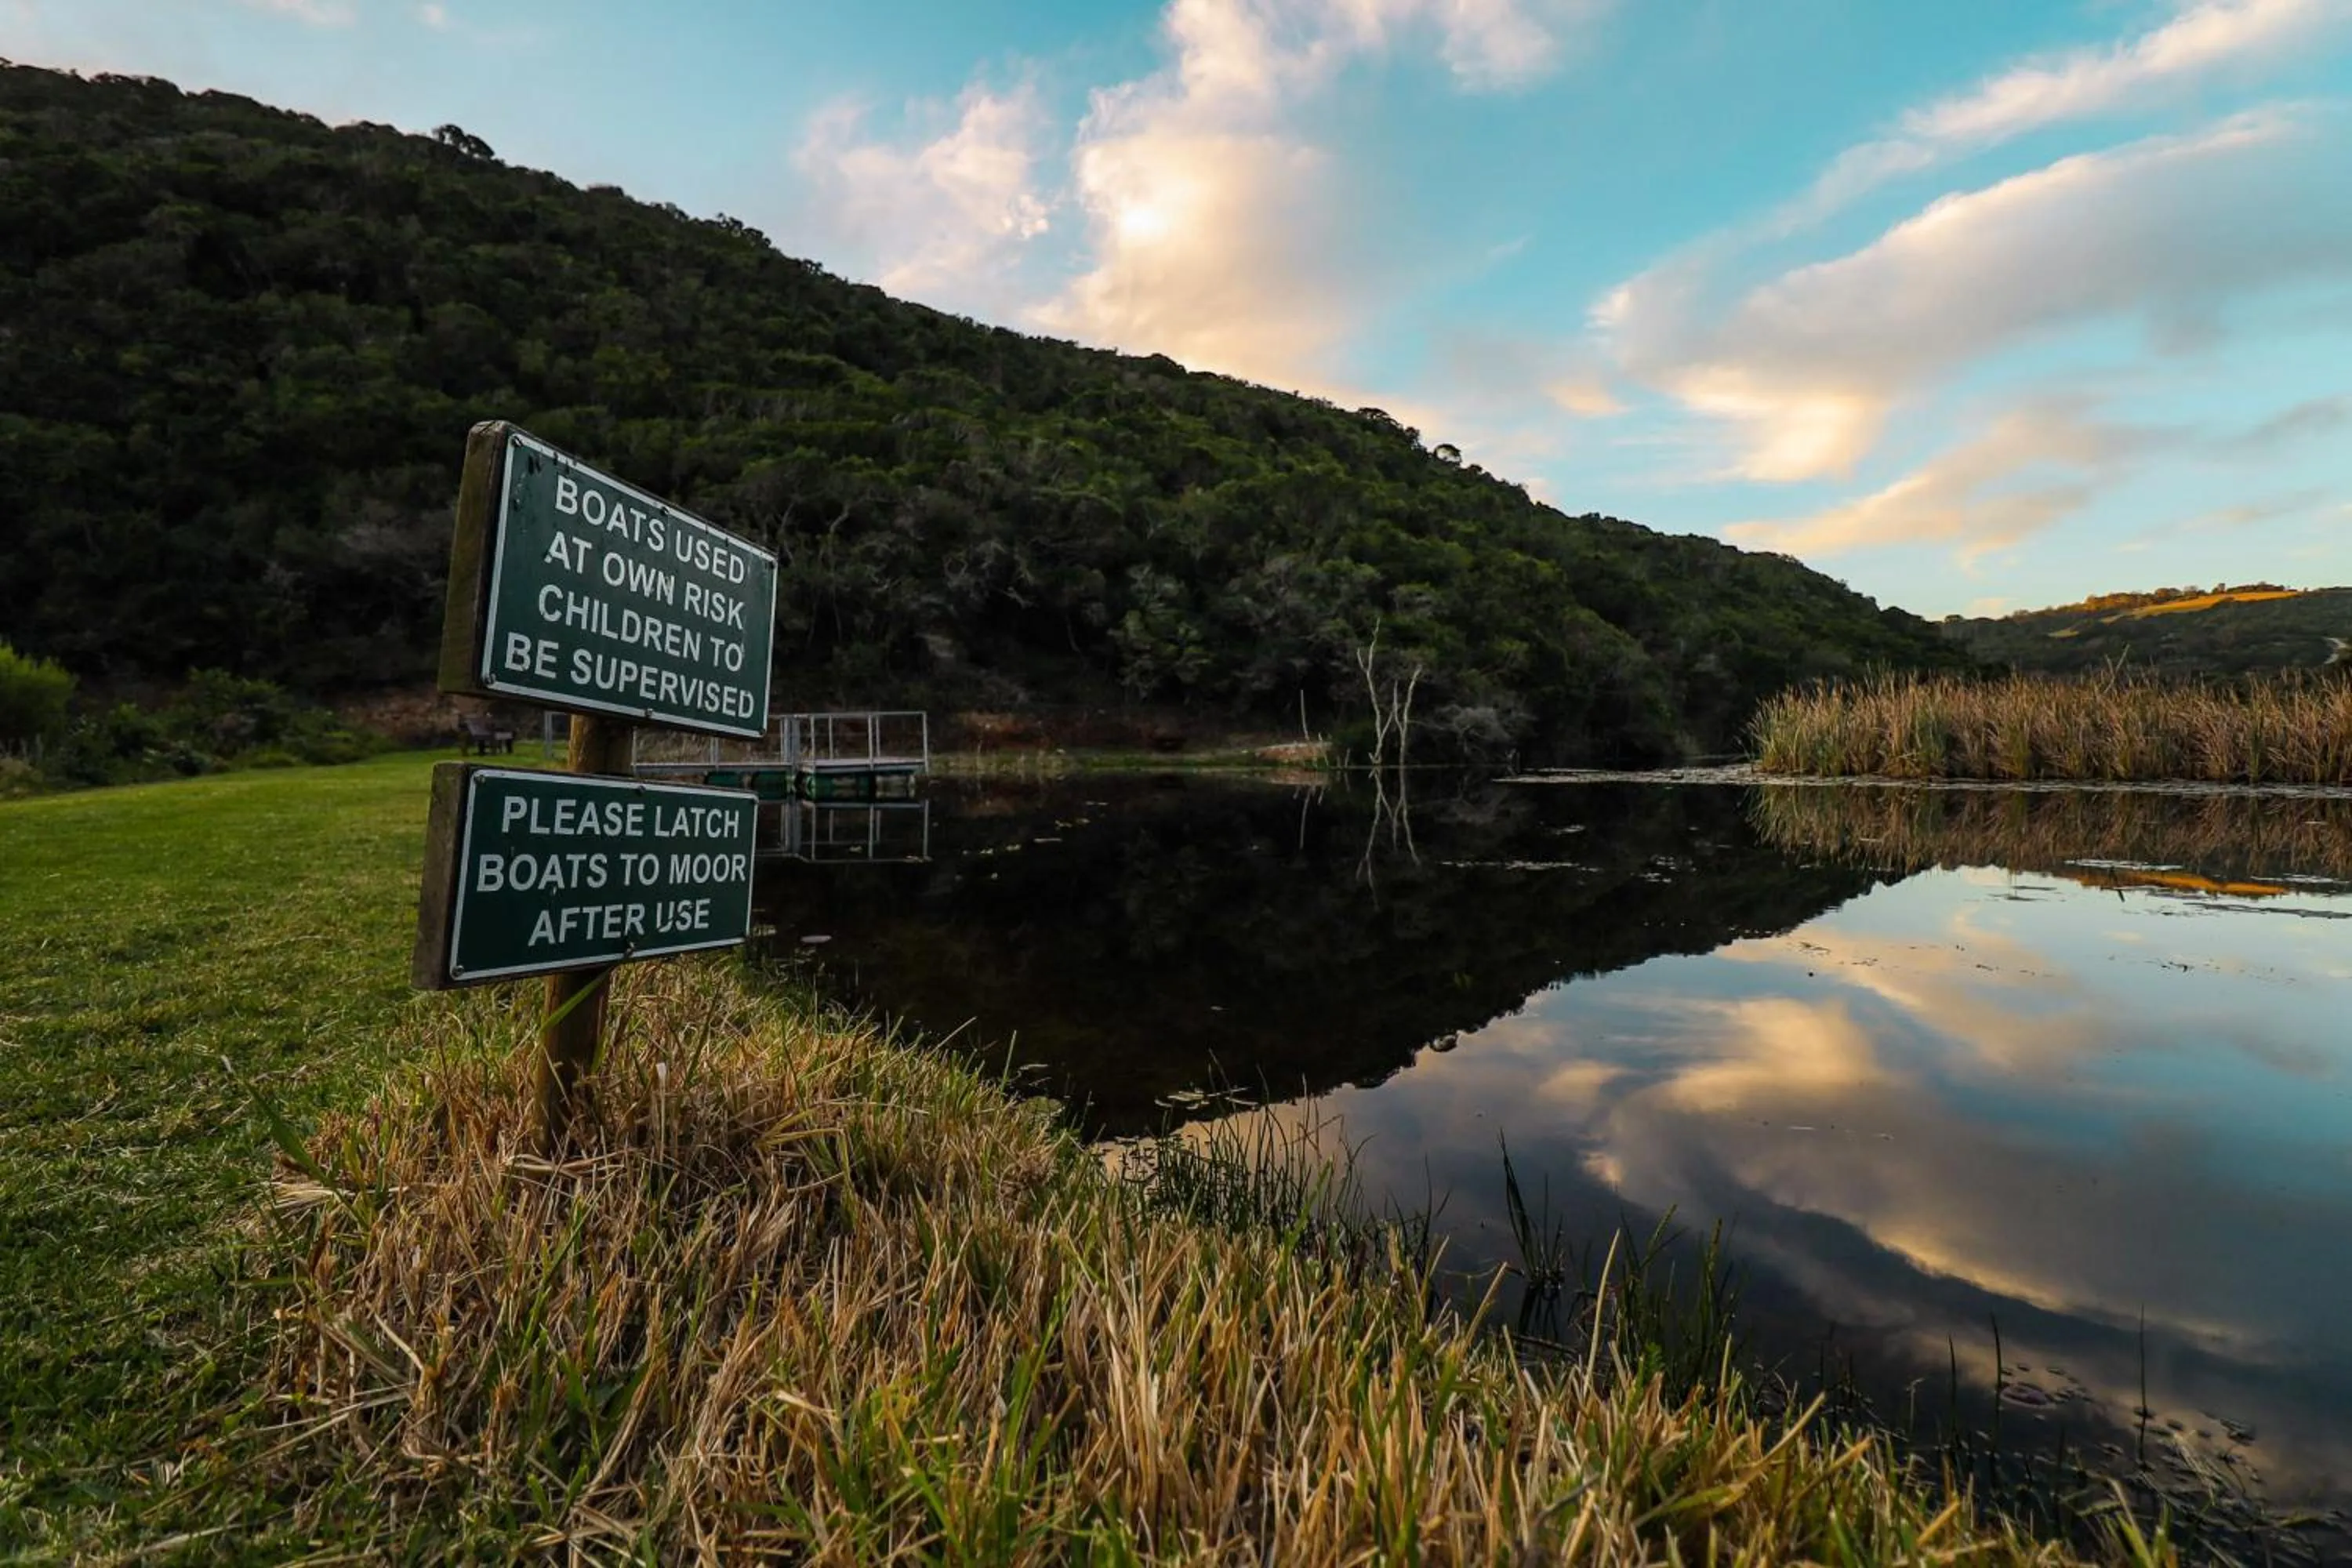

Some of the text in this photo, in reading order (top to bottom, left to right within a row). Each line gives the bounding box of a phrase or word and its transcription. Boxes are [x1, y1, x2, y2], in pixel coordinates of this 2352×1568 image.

[555, 475, 745, 584] BOATS USED
[543, 532, 744, 630] AT OWN RISK
[539, 584, 744, 672] CHILDREN TO
[504, 632, 755, 719] BE SUPERVISED
[502, 796, 739, 838] PLEASE LATCH
[477, 853, 746, 892] BOATS TO MOOR
[527, 898, 711, 947] AFTER USE
